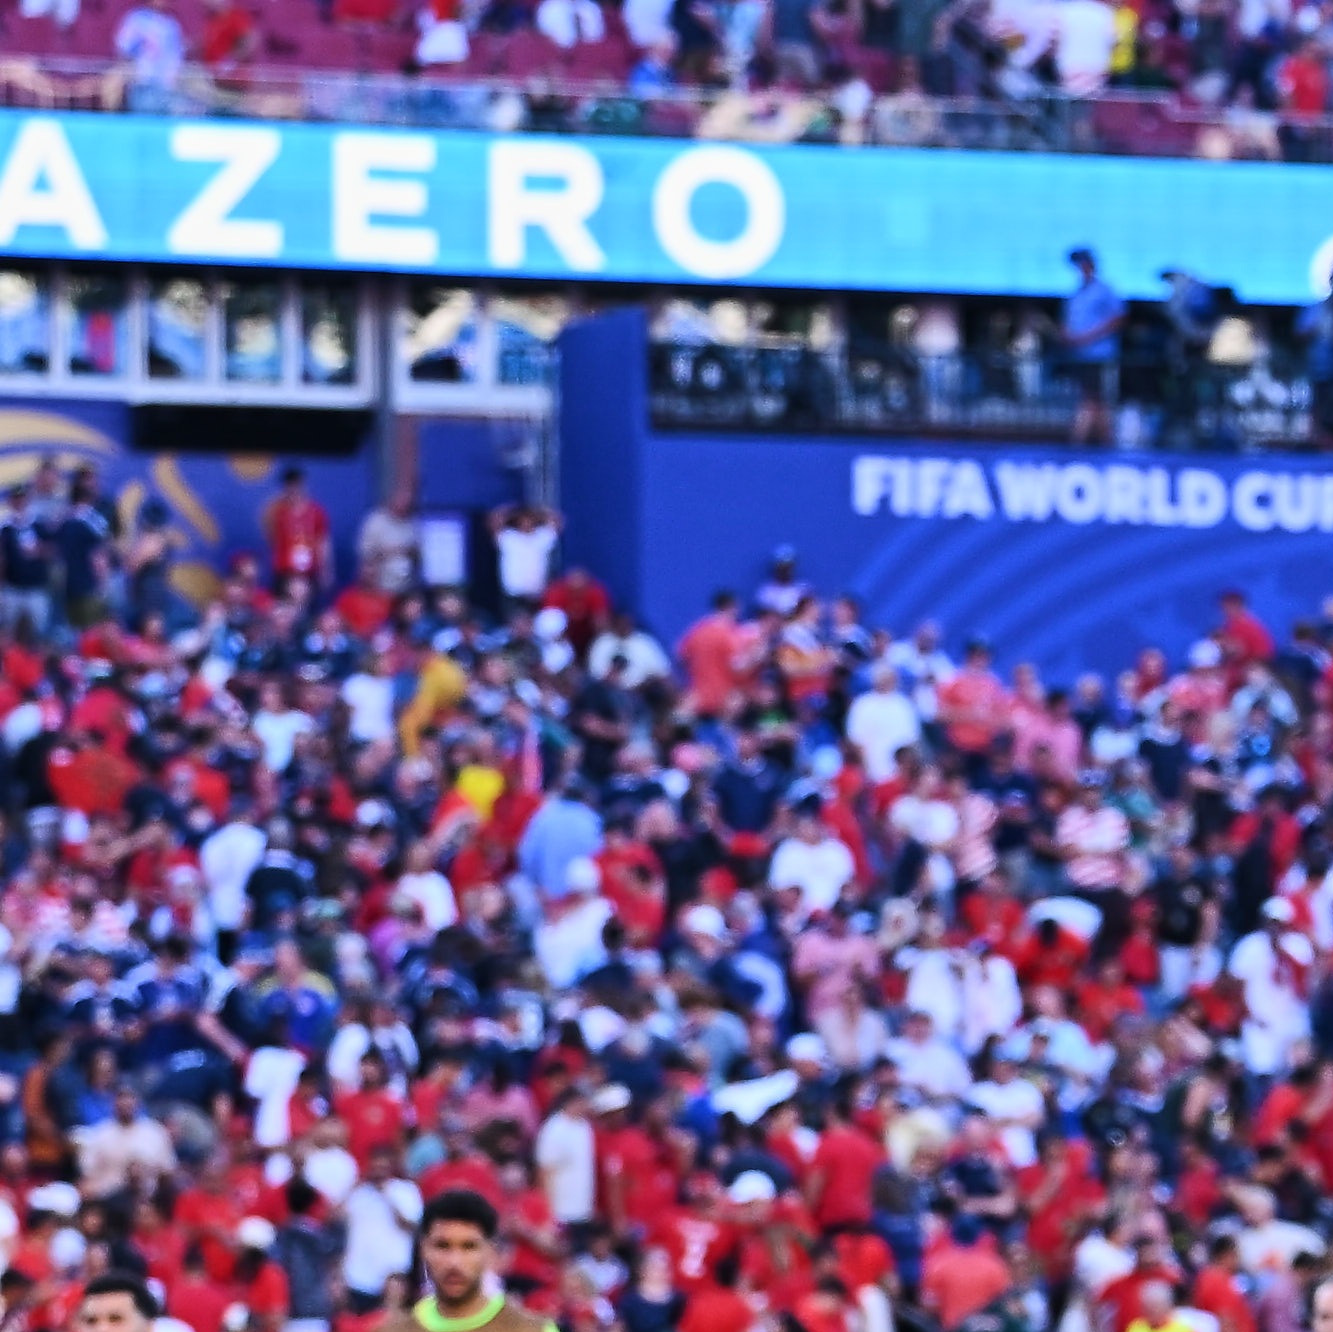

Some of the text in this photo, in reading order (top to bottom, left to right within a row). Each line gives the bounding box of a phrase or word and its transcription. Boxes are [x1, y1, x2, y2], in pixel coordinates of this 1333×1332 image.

[167, 125, 786, 280] ZERO
[853, 456, 995, 520] FIFA
[995, 460, 1228, 529] WORLD
